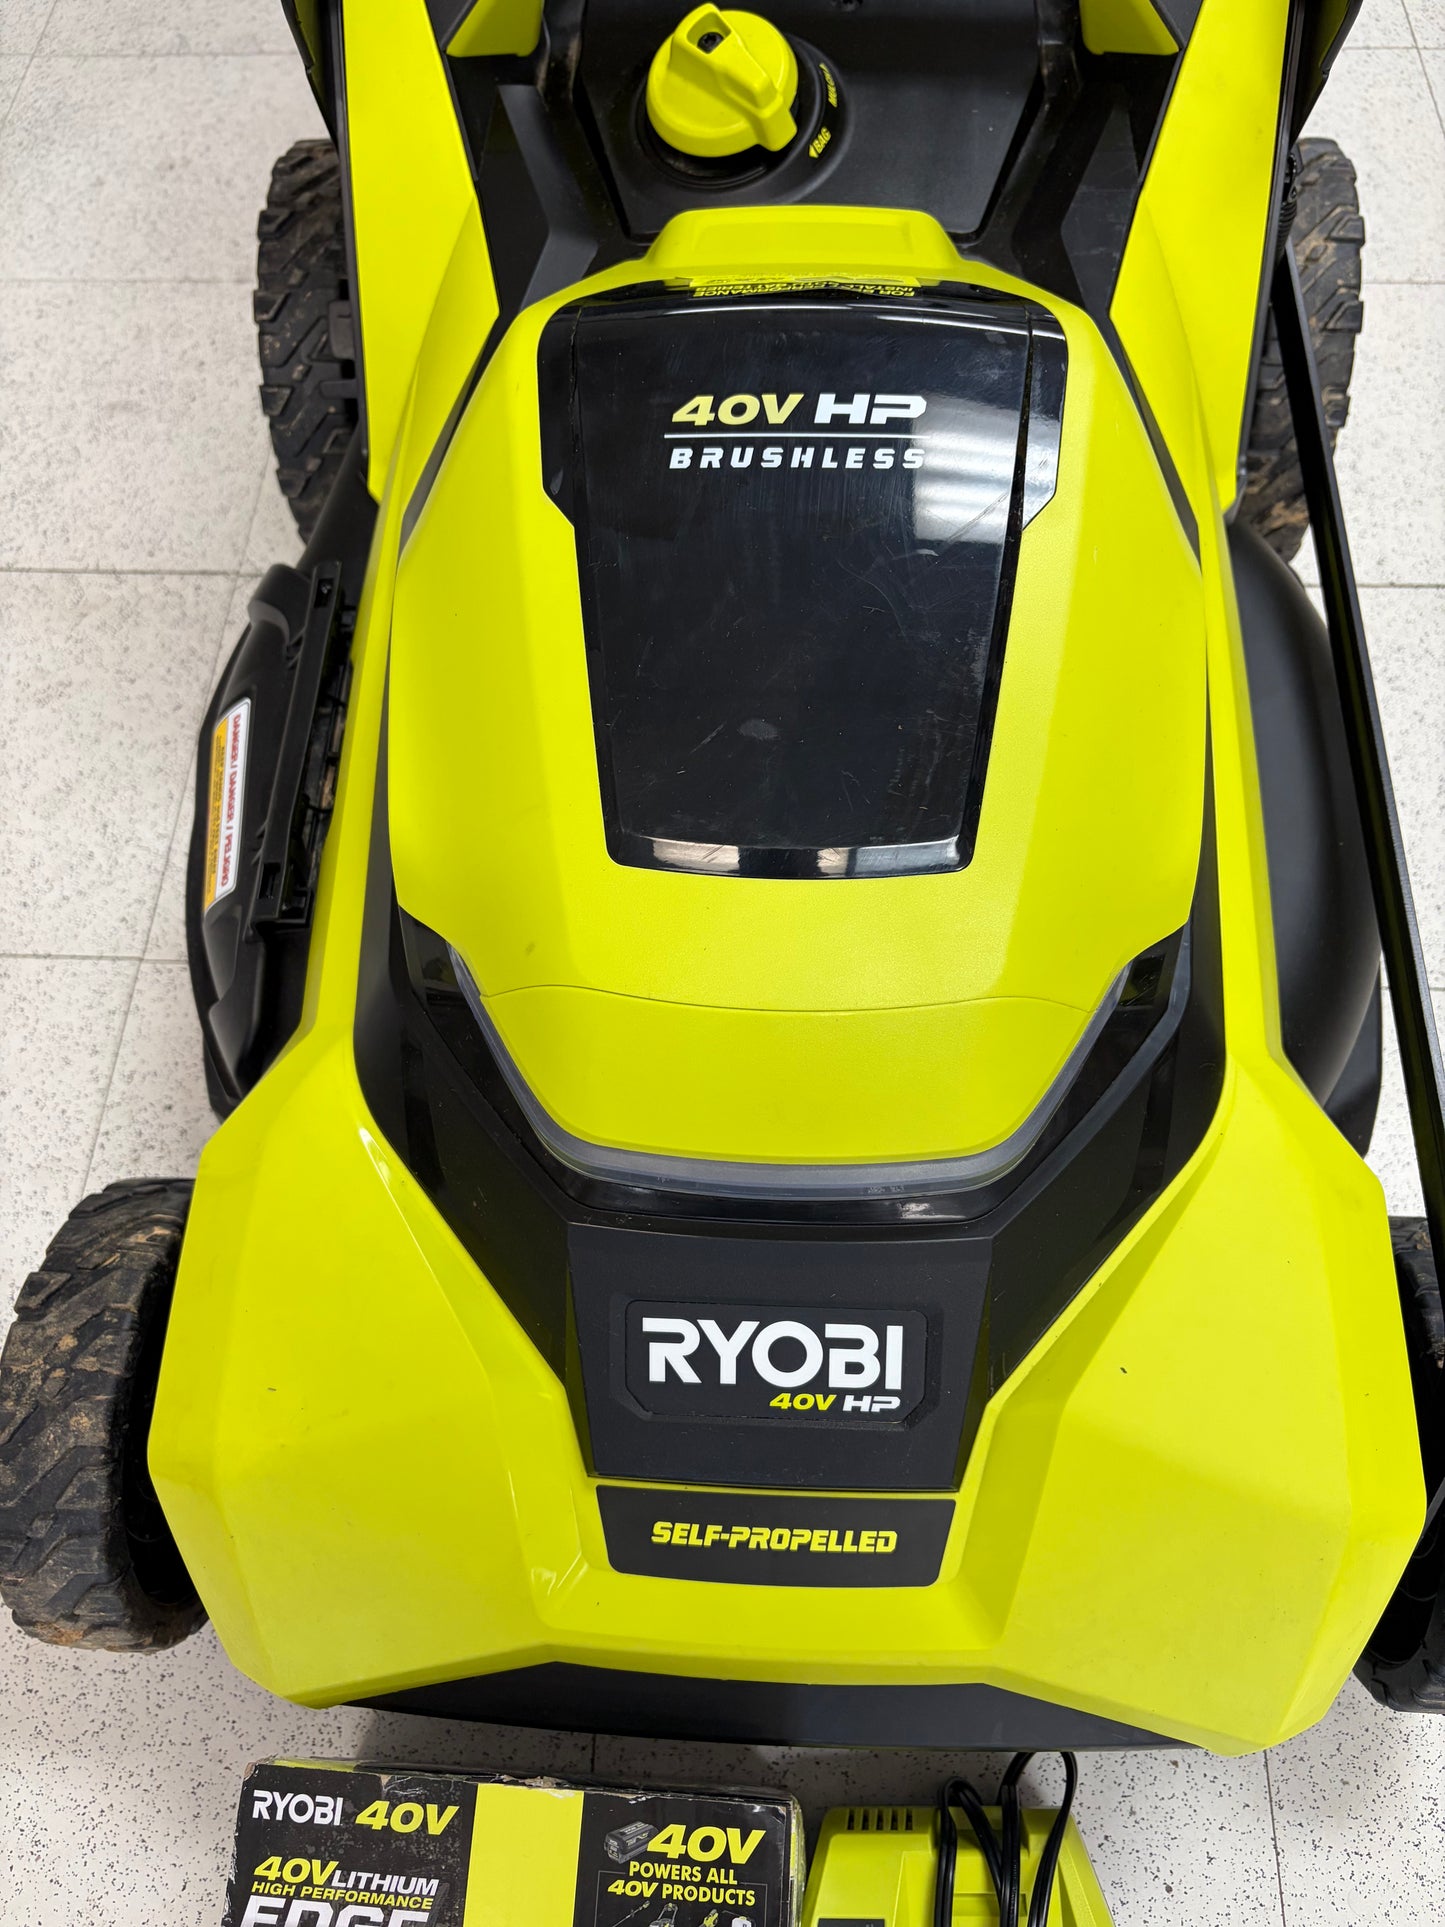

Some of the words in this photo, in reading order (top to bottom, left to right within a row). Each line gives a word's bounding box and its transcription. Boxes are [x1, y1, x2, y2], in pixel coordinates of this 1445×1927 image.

[813, 126, 832, 154] BAG
[879, 288, 915, 297] FOR
[671, 394, 804, 426] 40V
[813, 393, 927, 424] HP
[669, 446, 926, 469] BRUSHLESS
[642, 1317, 903, 1390] RYOBI
[769, 1392, 837, 1412] 40V
[842, 1395, 901, 1412] HP
[651, 1521, 898, 1554] SELF-PROPELLED
[252, 1789, 344, 1826] RYOBI
[355, 1800, 460, 1836] 40V
[646, 1823, 767, 1865] 40V
[628, 1861, 702, 1883] POWERS
[705, 1868, 738, 1886] ALL
[251, 1881, 297, 1897] HIGH
[300, 1886, 435, 1910] PERFORMANCE
[607, 1879, 659, 1898] 40V
[661, 1883, 757, 1907] PRODUCTS
